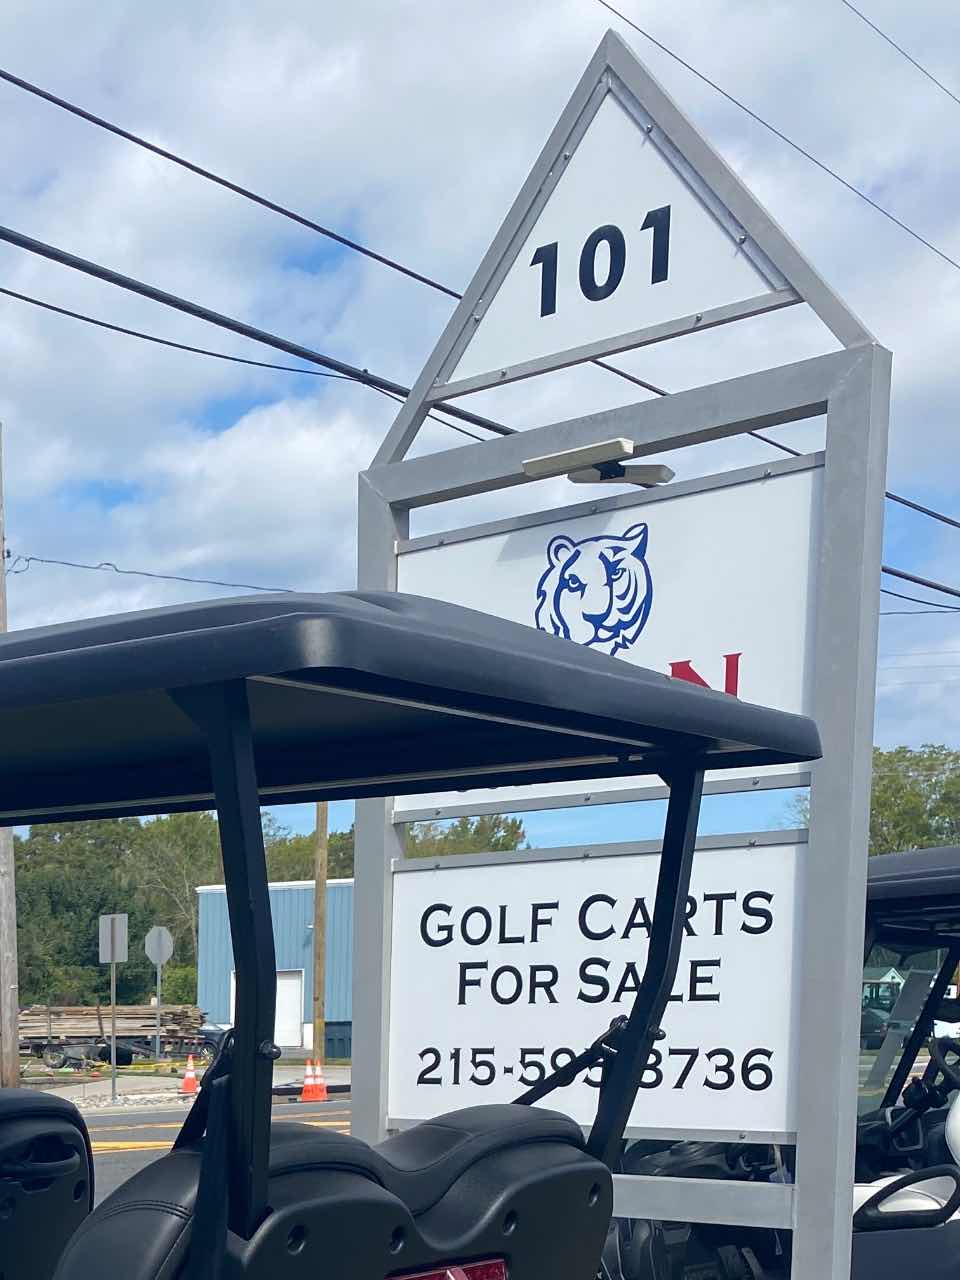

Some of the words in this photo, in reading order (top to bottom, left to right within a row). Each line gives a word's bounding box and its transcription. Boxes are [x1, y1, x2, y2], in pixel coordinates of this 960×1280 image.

[529, 204, 672, 318] 101
[419, 901, 560, 948] GOLF
[578, 890, 775, 941] CARTS
[457, 959, 559, 1006] FOR
[577, 956, 722, 1004] SAE
[416, 1045, 775, 1092] 215-598736
